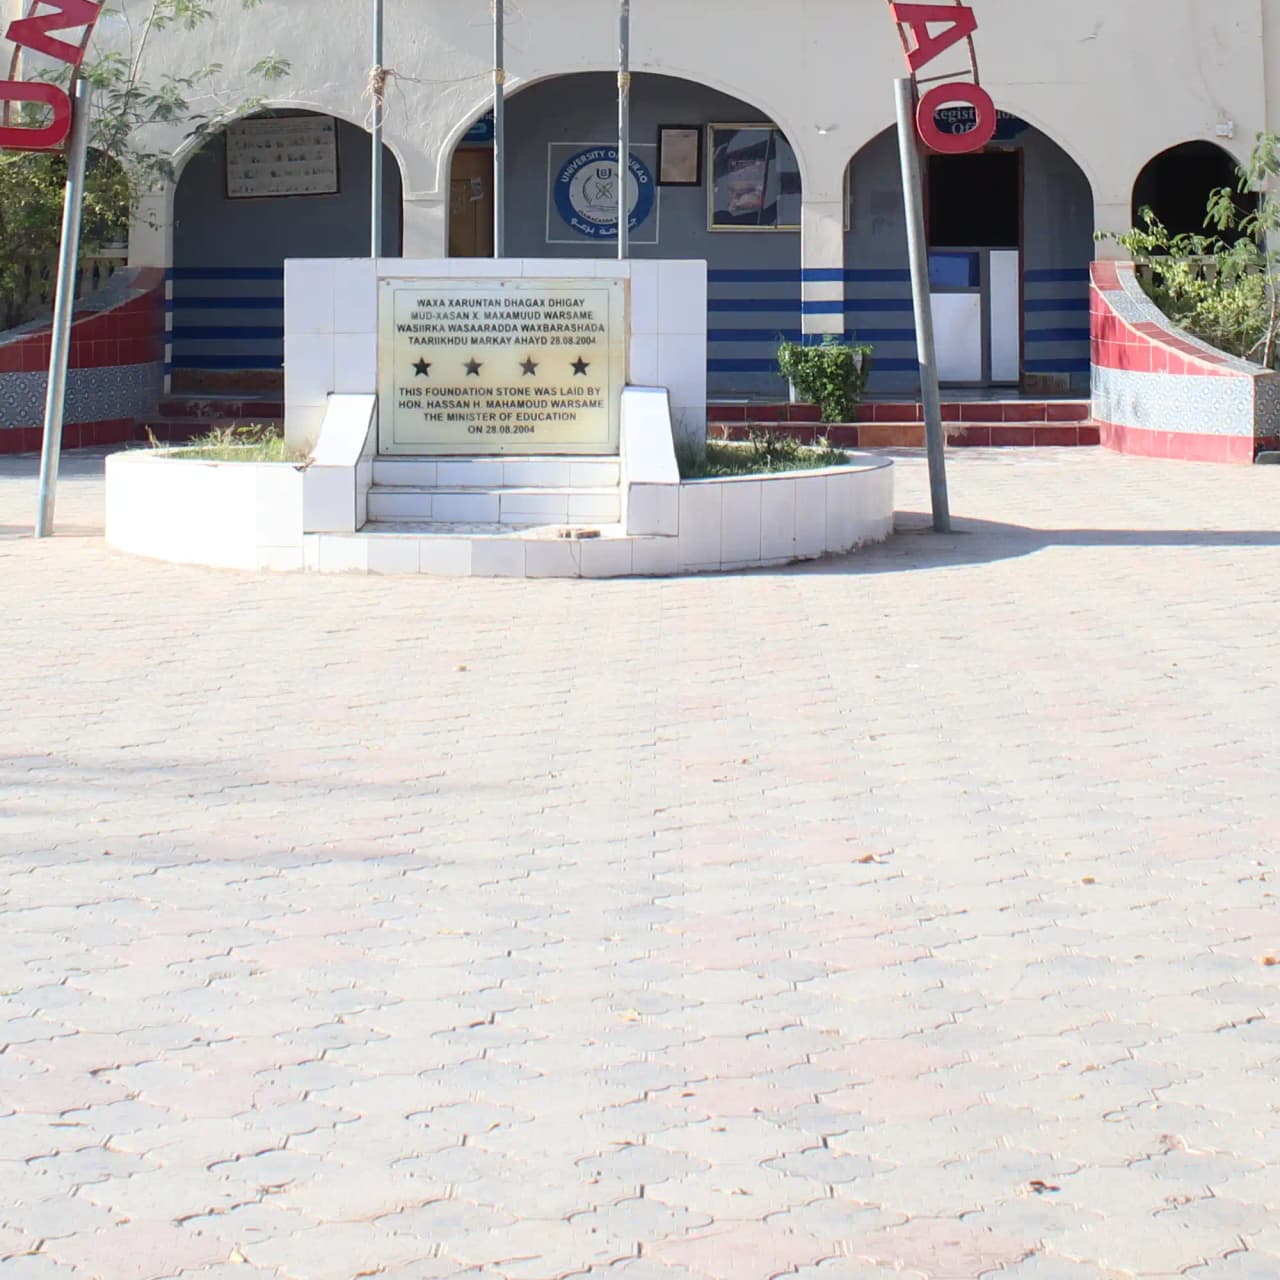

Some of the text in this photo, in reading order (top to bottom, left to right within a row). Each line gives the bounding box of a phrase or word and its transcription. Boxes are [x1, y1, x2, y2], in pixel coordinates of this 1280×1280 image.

[417, 299, 585, 308] WAXA XARUNTAN DHAGAX DHIGAY
[484, 311, 541, 320] MAXAMUUD
[543, 311, 593, 320] WARSAME
[397, 324, 605, 333] WASIIRKA WASAARADDA WAXBARASHADA
[408, 336, 597, 345] TAARIIKHDU MARKAY AHAYD 28.08.2004
[400, 387, 601, 396] THIS FOUNDATION STONE WAS LAID BY
[399, 400, 423, 409] HON.
[427, 400, 470, 409] HASSAN
[486, 400, 548, 409] MAHAMOUD
[551, 400, 605, 409] WARSAME
[424, 412, 577, 421] THE MINISTER OF EDUCATION
[467, 425, 535, 434] ON 28.08.2004
